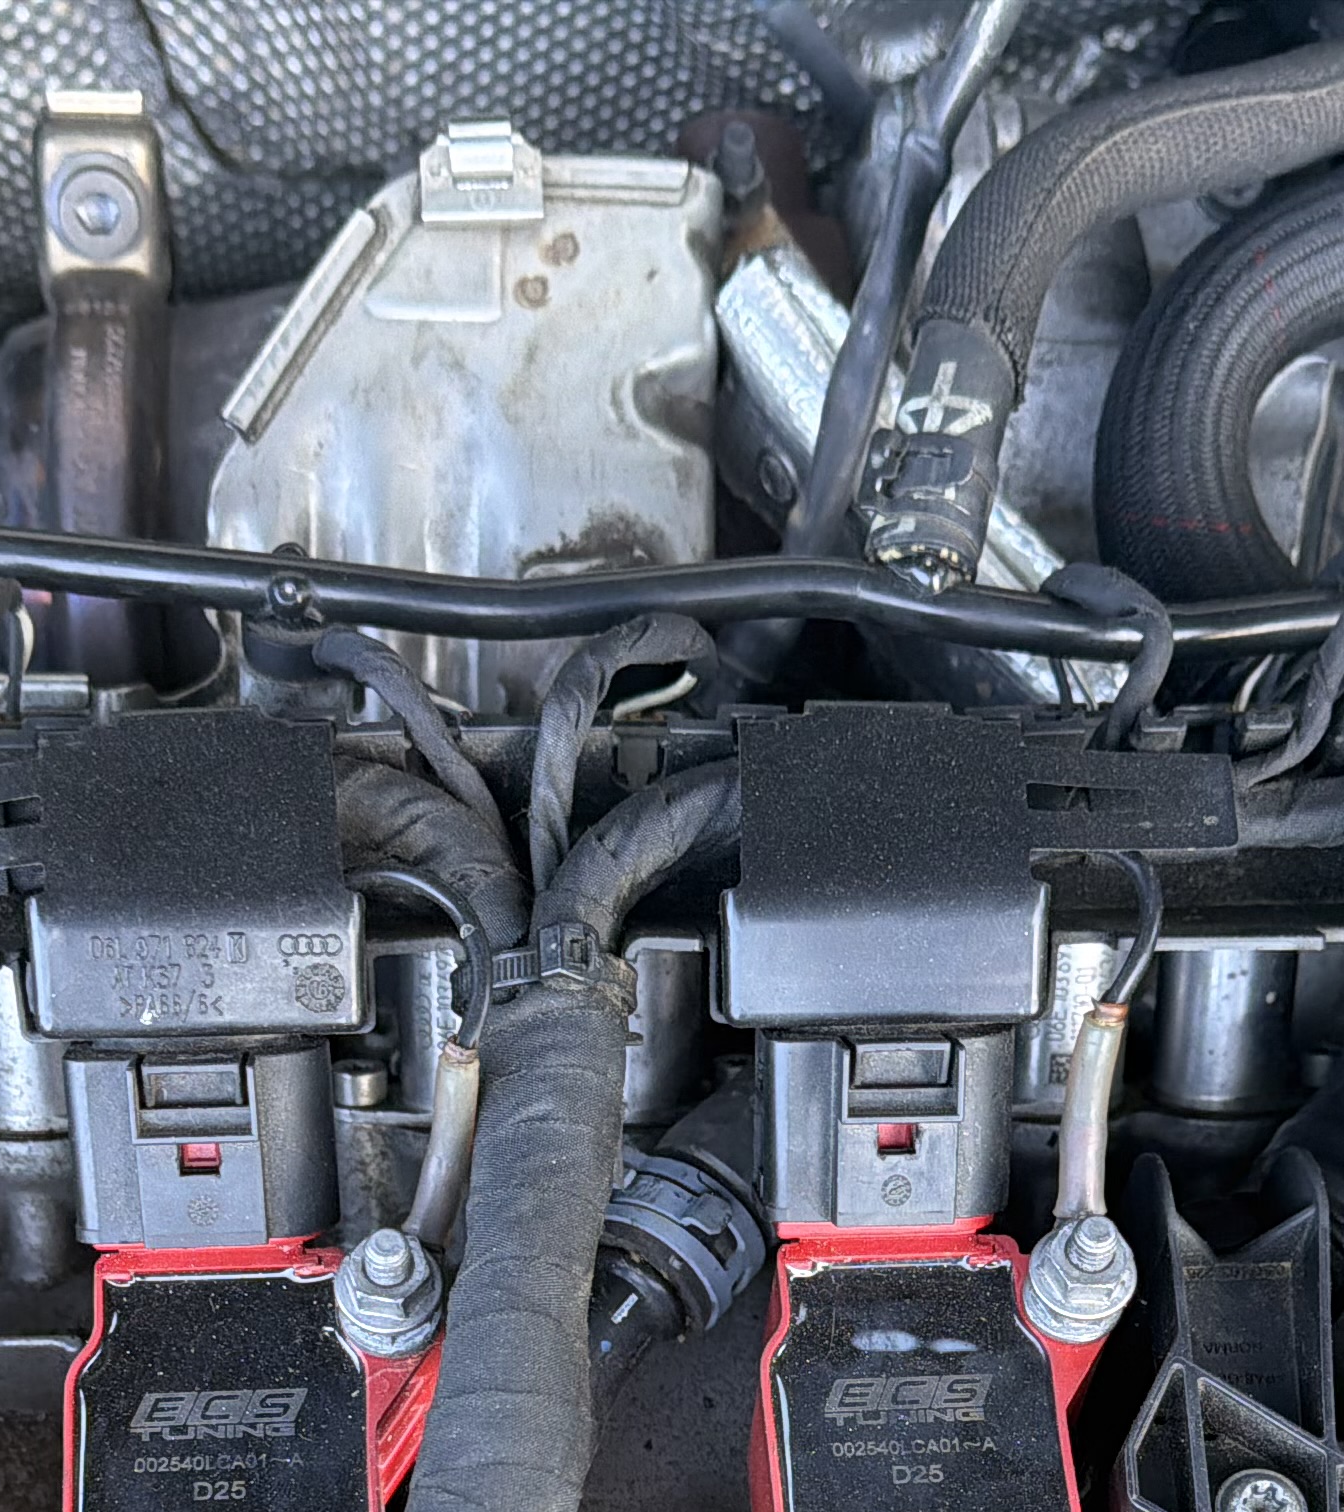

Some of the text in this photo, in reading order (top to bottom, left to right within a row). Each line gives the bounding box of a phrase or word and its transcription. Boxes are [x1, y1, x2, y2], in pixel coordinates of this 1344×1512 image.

[826, 1374, 993, 1412] ECS
[130, 1387, 309, 1428] ECS
[824, 1408, 986, 1427] TUNING
[130, 1425, 297, 1441] TUNING
[892, 1465, 945, 1485] D25
[193, 1481, 247, 1502] D25
